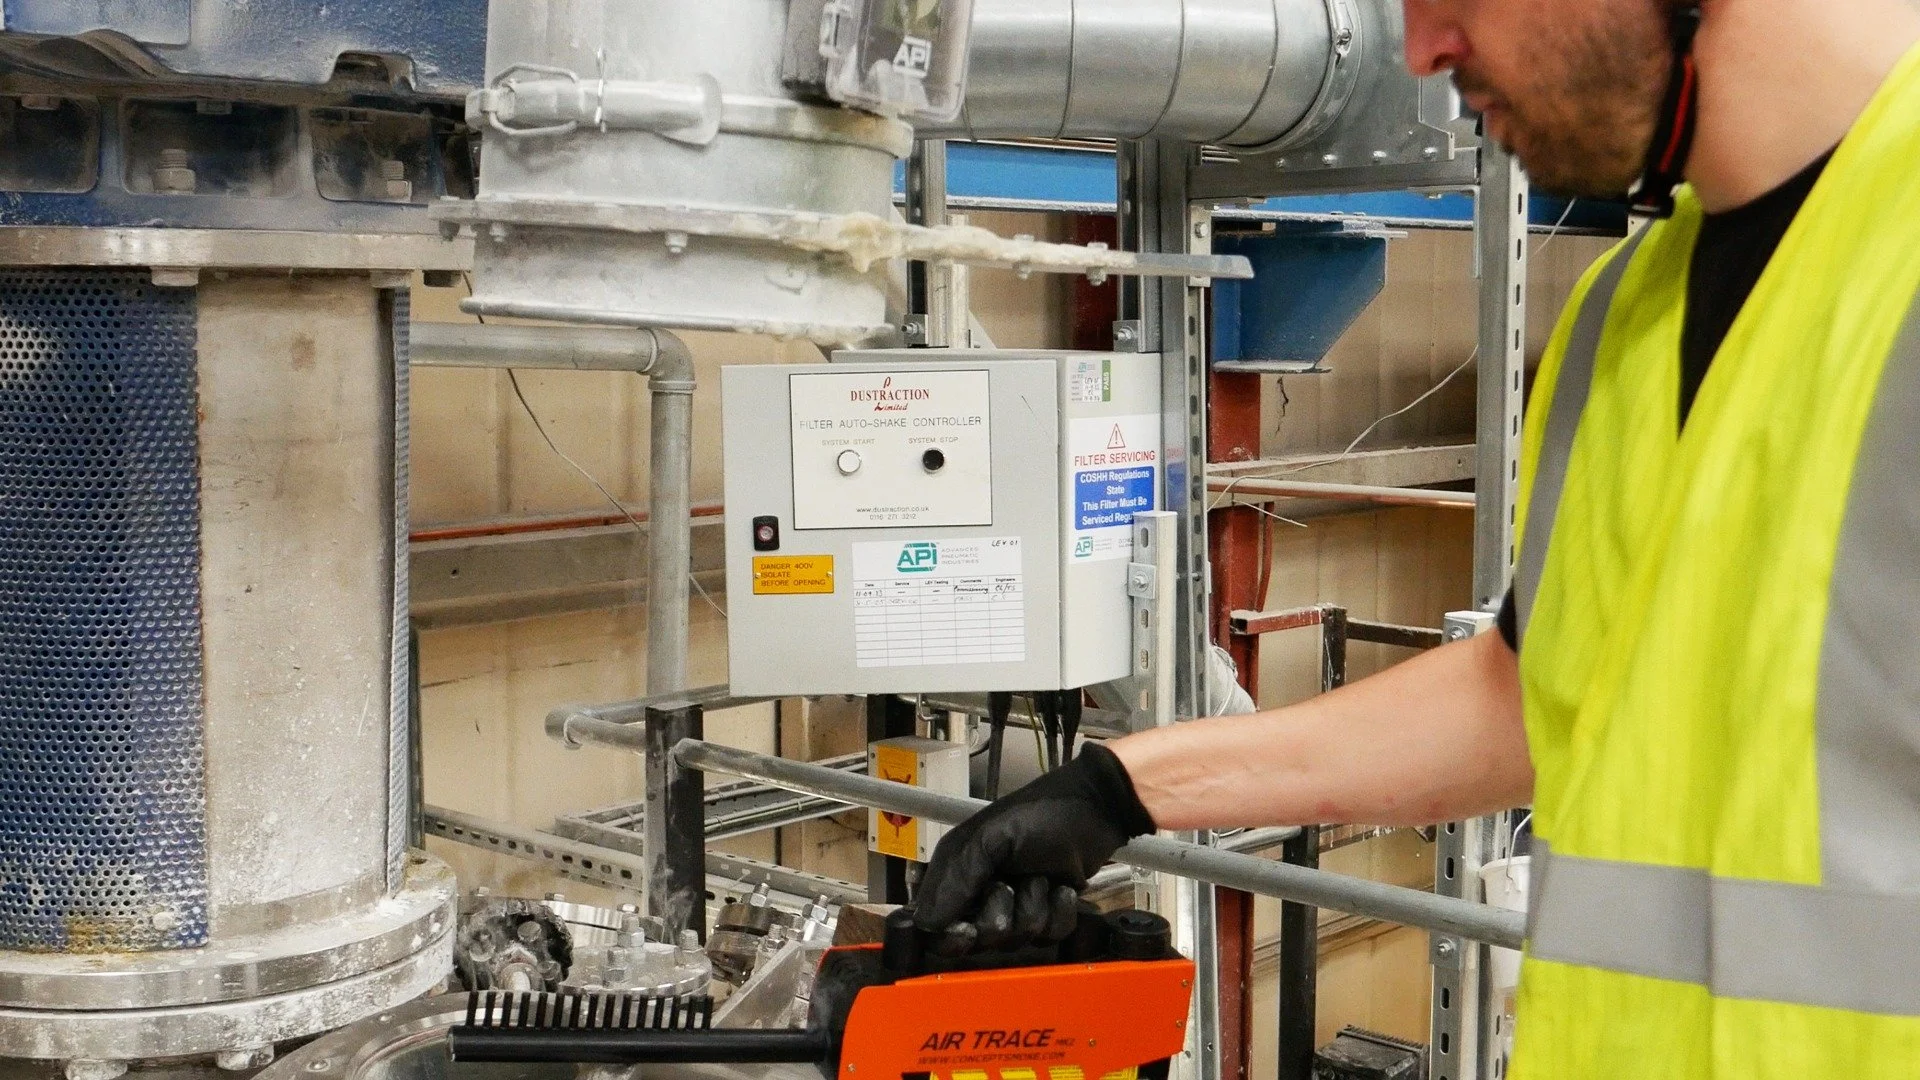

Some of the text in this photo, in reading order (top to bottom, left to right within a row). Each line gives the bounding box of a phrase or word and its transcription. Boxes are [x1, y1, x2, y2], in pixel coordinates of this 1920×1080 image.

[850, 388, 930, 401] DUSTRACTION
[873, 402, 908, 412] Limited
[799, 416, 982, 429] FILTER AUTO-SHAKE CONTROLLER
[1074, 453, 1106, 466] FILTER
[1109, 450, 1156, 464] SERVICING
[1080, 469, 1150, 484] COSHH Regulations
[1106, 485, 1125, 495] State
[1082, 496, 1148, 511] This Filter Must Be
[1082, 512, 1114, 526] Serviced
[1074, 539, 1093, 553] API
[897, 548, 938, 567] API
[793, 578, 826, 586] OPENING
[920, 1032, 967, 1051] AIR
[971, 1028, 1056, 1048] TRACE
